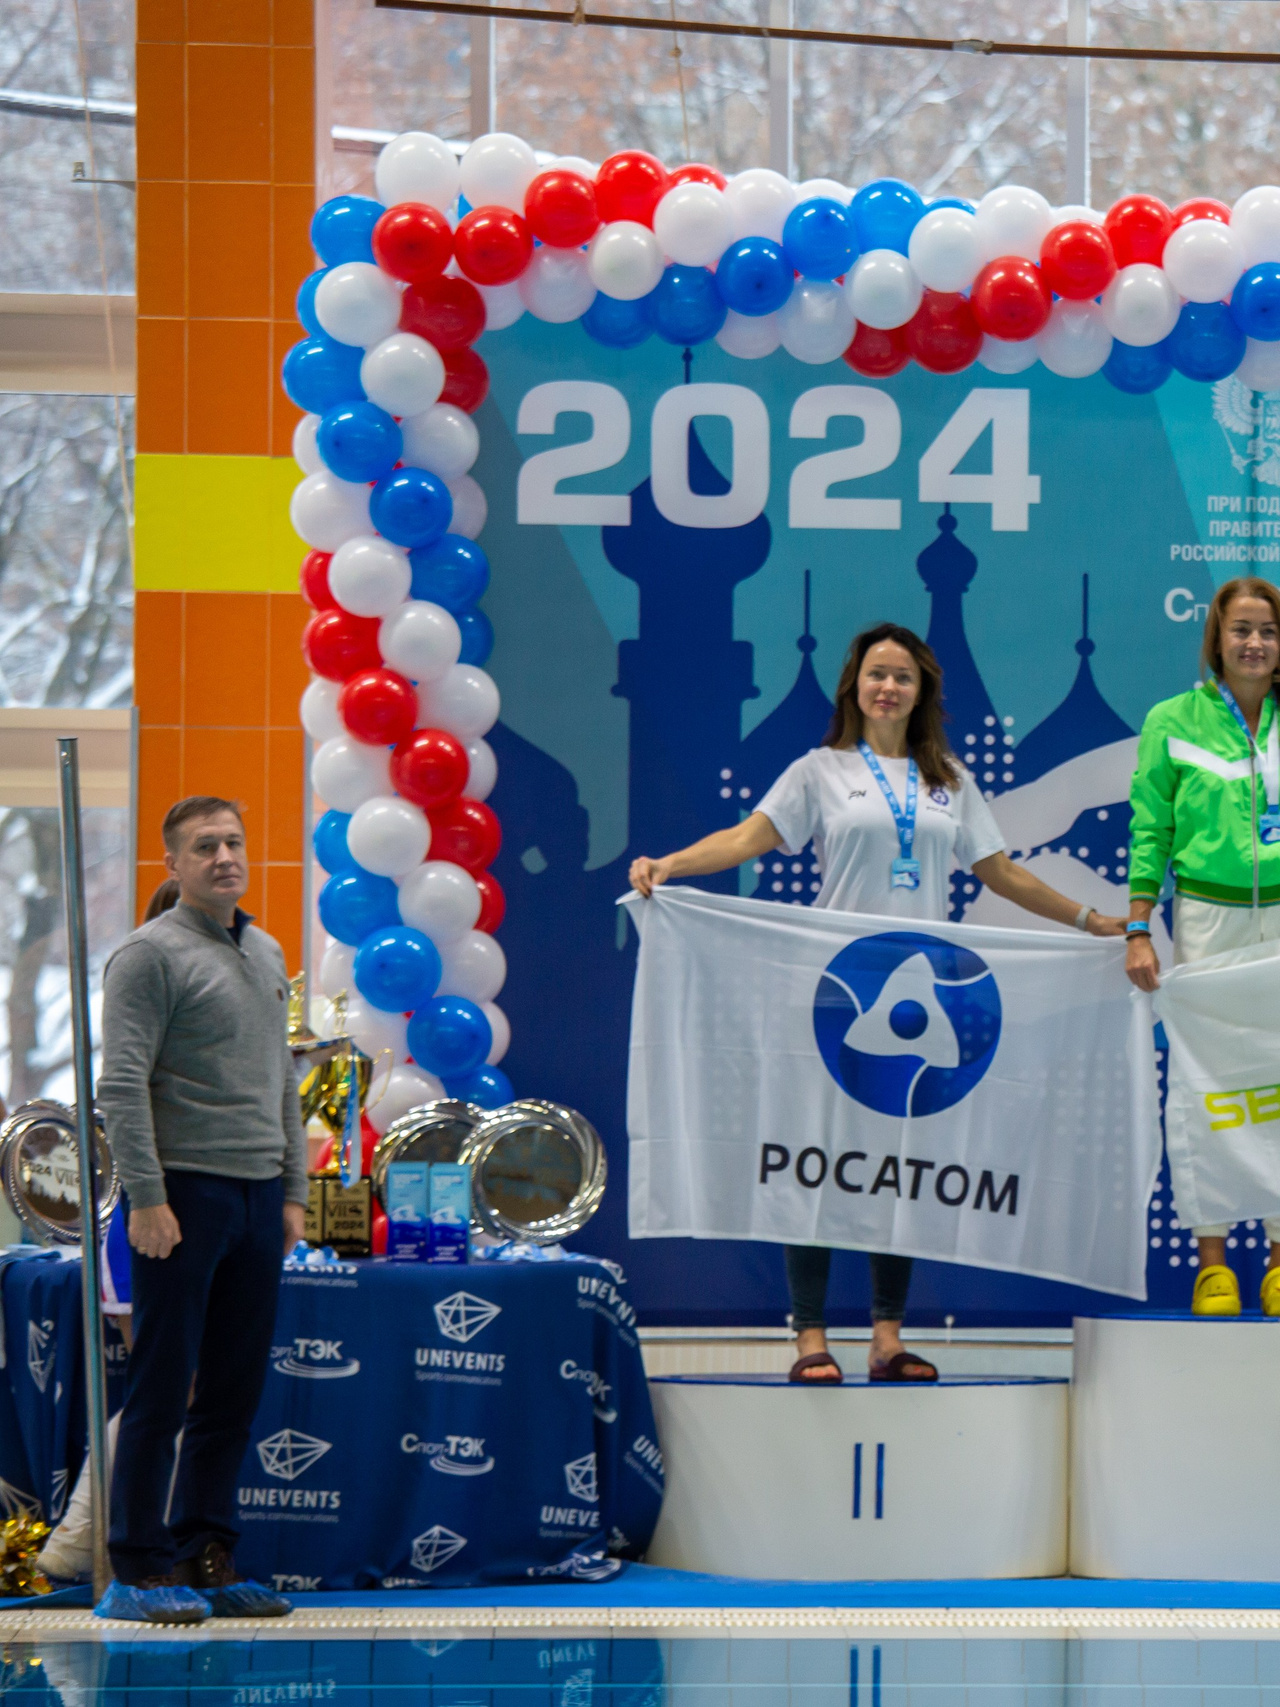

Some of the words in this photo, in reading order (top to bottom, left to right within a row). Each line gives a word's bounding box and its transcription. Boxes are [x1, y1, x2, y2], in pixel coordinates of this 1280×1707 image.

[517, 380, 1041, 532] 2024
[1207, 496, 1241, 513] ПРИ
[1170, 541, 1280, 563] РОССИЙСКОЙ
[758, 1142, 1020, 1216] РОСАТОМ
[415, 1347, 506, 1372] UNEVENTS
[852, 1442, 886, 1520] II
[238, 1487, 341, 1509] UNEVENTS
